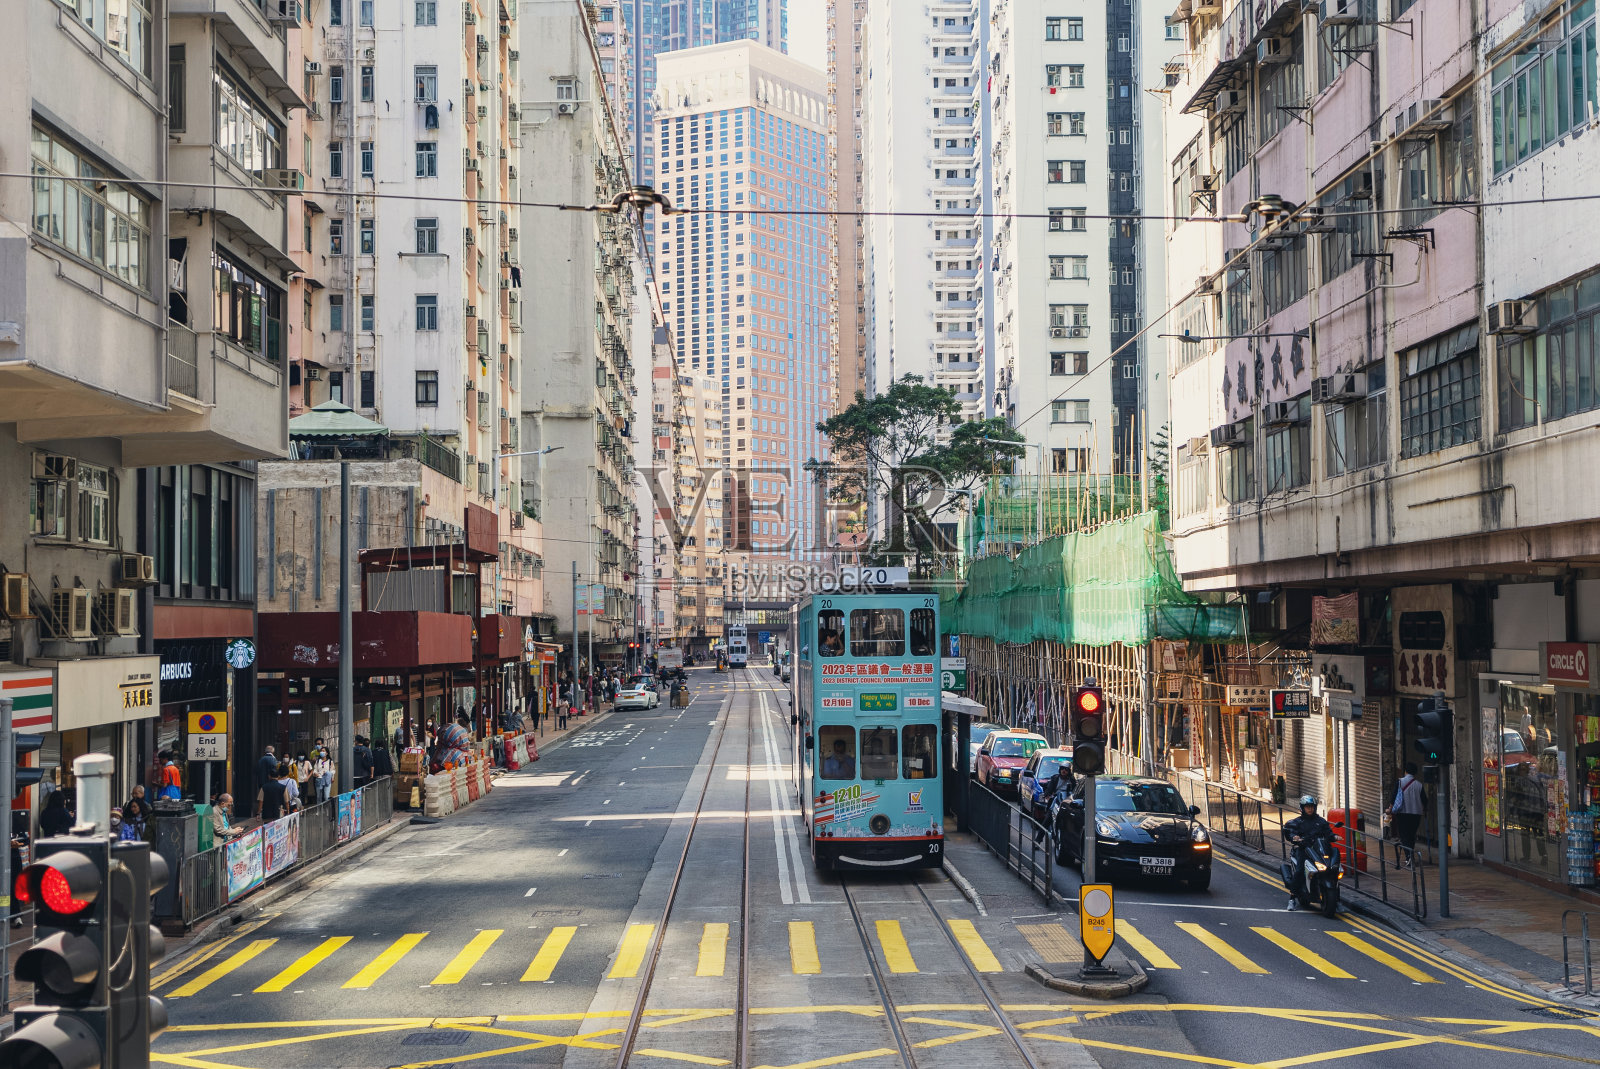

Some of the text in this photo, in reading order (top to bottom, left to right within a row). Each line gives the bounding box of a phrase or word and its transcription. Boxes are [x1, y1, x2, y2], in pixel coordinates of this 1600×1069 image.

[863, 569, 888, 584] 20
[821, 599, 833, 609] 20
[924, 598, 935, 608] 20
[1550, 649, 1586, 676] CIRCLE K
[160, 662, 192, 680] ARBUCKS
[821, 663, 935, 676] 2023年區議會一般選舉
[822, 698, 852, 707] 12月10日
[861, 694, 878, 702] Happy
[908, 698, 931, 706] 10 Dec
[198, 736, 216, 745] End
[195, 747, 220, 758] 終止
[928, 843, 939, 853] 20
[1154, 858, 1173, 866] 3818
[1087, 918, 1106, 926] B245
